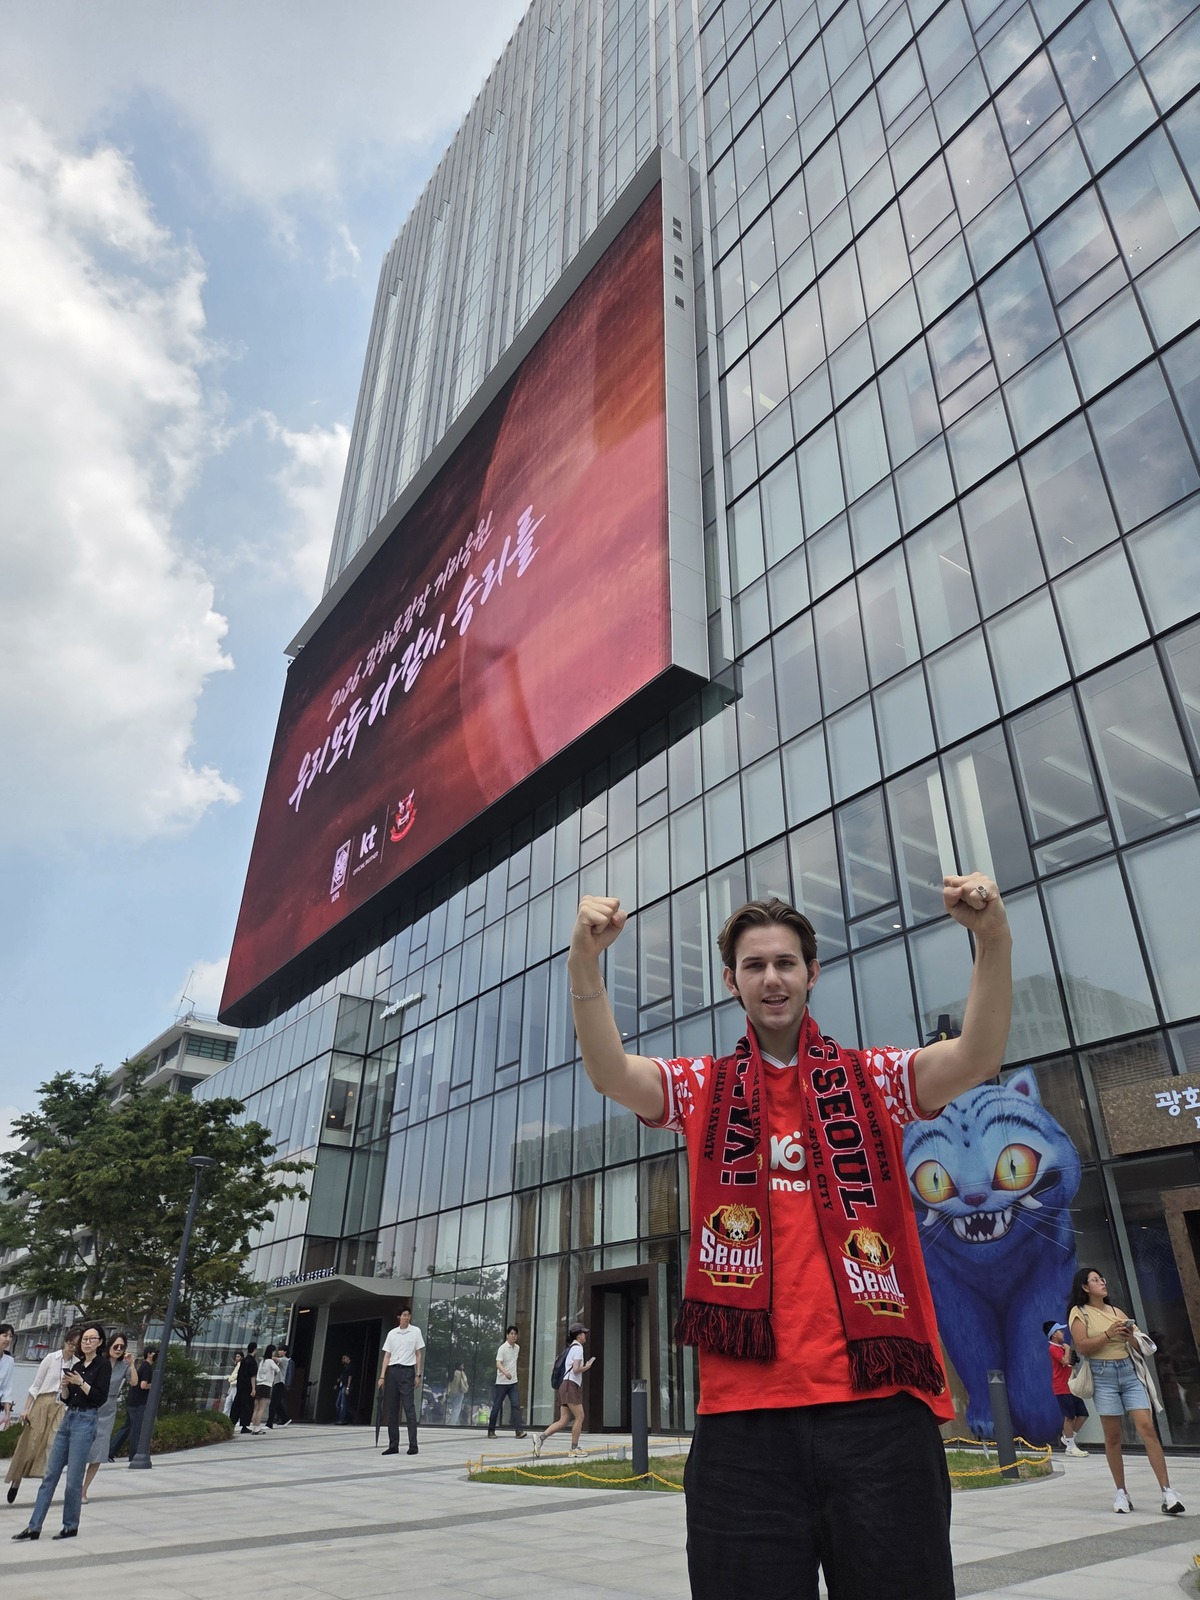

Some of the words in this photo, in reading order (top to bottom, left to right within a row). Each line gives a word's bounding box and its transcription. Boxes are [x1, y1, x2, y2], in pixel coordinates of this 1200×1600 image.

[451, 504, 546, 636] 승리를
[327, 661, 362, 722] 2026
[362, 584, 432, 679] 광화문광장
[434, 510, 495, 597] 거리응원
[704, 1107, 720, 1160] ALWAYS
[713, 1071, 726, 1105] WITH
[752, 1088, 760, 1113] RED
[861, 1092, 873, 1109] AS
[810, 1065, 877, 1221] SEOUL
[866, 1110, 881, 1138] ONE
[808, 1126, 824, 1169] SEOUL
[816, 1173, 834, 1211] CITY
[874, 1139, 892, 1182] TEAM
[700, 1225, 764, 1268] Seoul
[842, 1256, 905, 1299] Seoul
